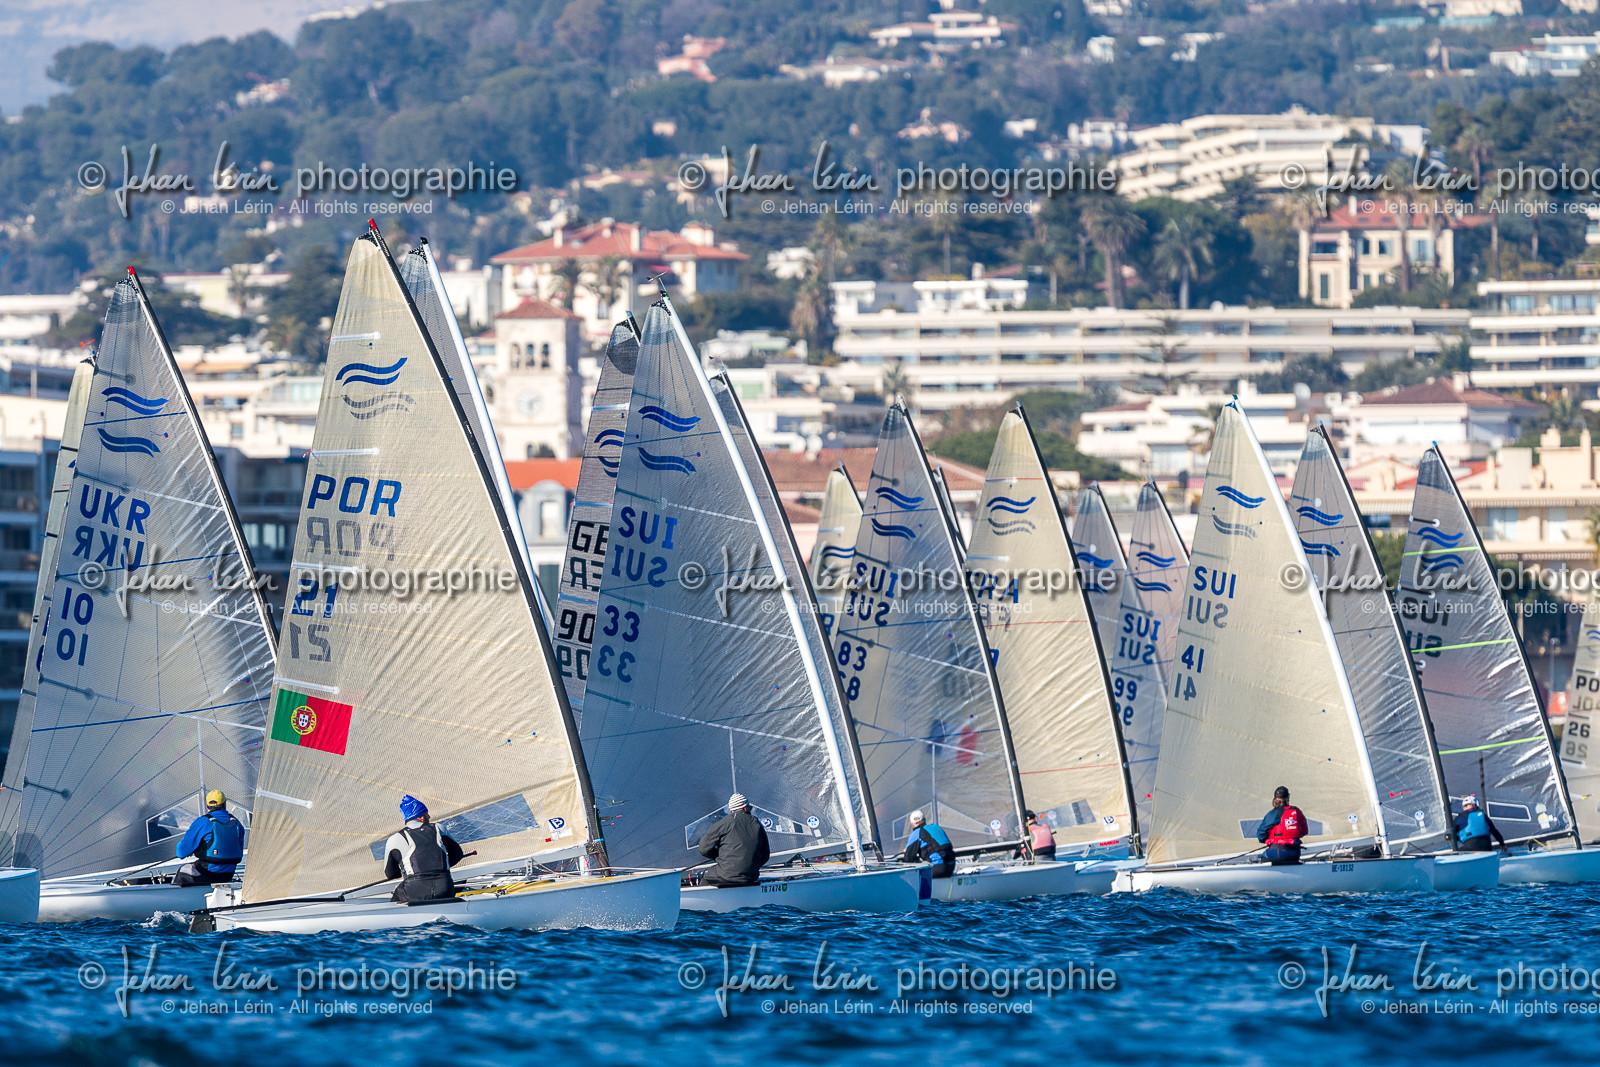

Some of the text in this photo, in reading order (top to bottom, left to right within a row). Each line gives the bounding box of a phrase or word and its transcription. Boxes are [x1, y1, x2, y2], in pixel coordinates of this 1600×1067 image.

[79, 484, 150, 534] UKR
[307, 473, 402, 517] POR
[618, 506, 678, 550] SUI
[291, 578, 339, 618] 21
[855, 562, 899, 598] SUI
[1193, 566, 1237, 599] SUI
[61, 587, 93, 626] 10
[603, 605, 640, 643] 33
[1123, 613, 1161, 641] SUI
[838, 641, 867, 671] 83
[1181, 644, 1205, 673] 41
[1114, 677, 1138, 701] 99
[1568, 721, 1591, 738] 26
